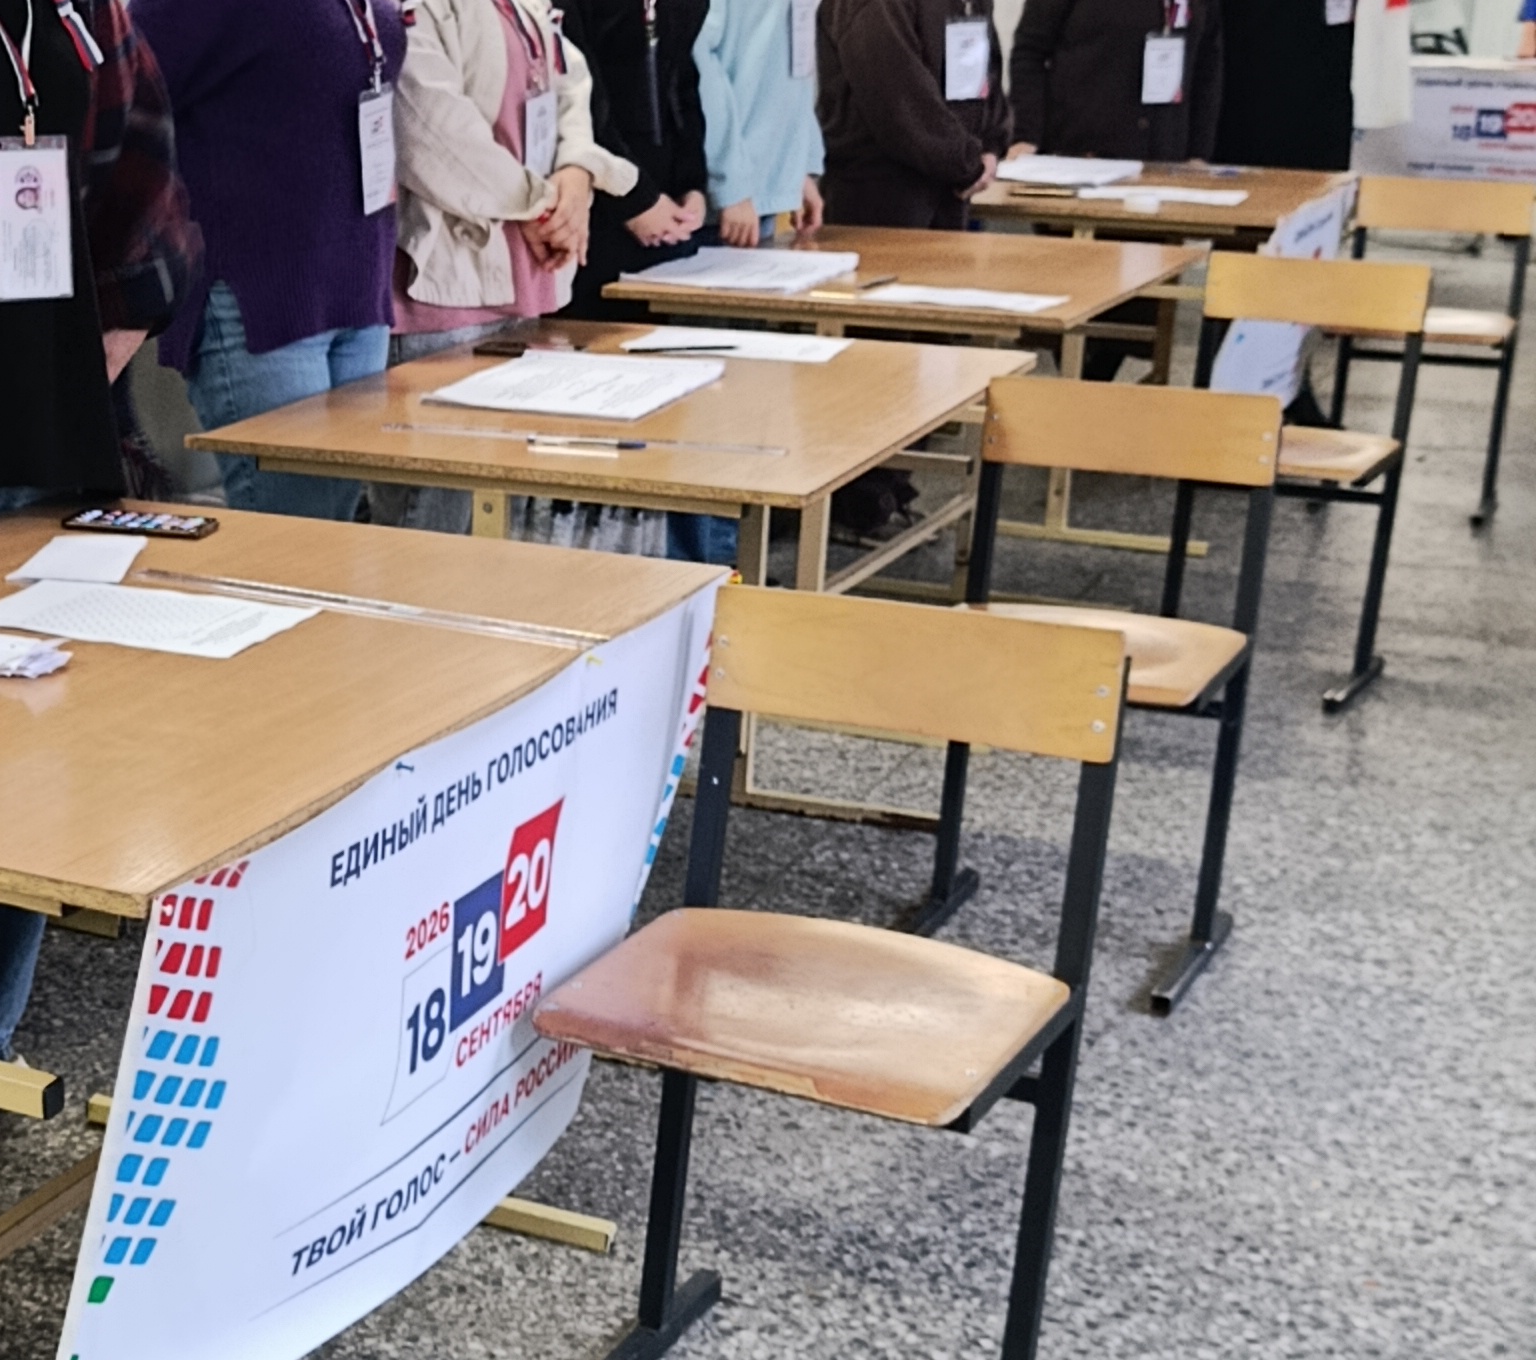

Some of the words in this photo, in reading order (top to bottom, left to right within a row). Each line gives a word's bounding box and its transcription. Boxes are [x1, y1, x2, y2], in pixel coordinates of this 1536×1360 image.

[330, 794, 427, 889] ЕДИНЫЙ
[432, 771, 482, 833] ДЕНЬ
[487, 687, 618, 791] ГОЛОСОВАНИЯ
[404, 901, 450, 961] 2026
[505, 837, 551, 931] 20
[457, 910, 498, 999] 19
[407, 987, 446, 1076] 18
[455, 970, 543, 1070] СЕНТЯБРЯ
[292, 1203, 367, 1276] ТВОЙ
[371, 1153, 446, 1230] ГОЛОС
[464, 1092, 510, 1155] СИЛА
